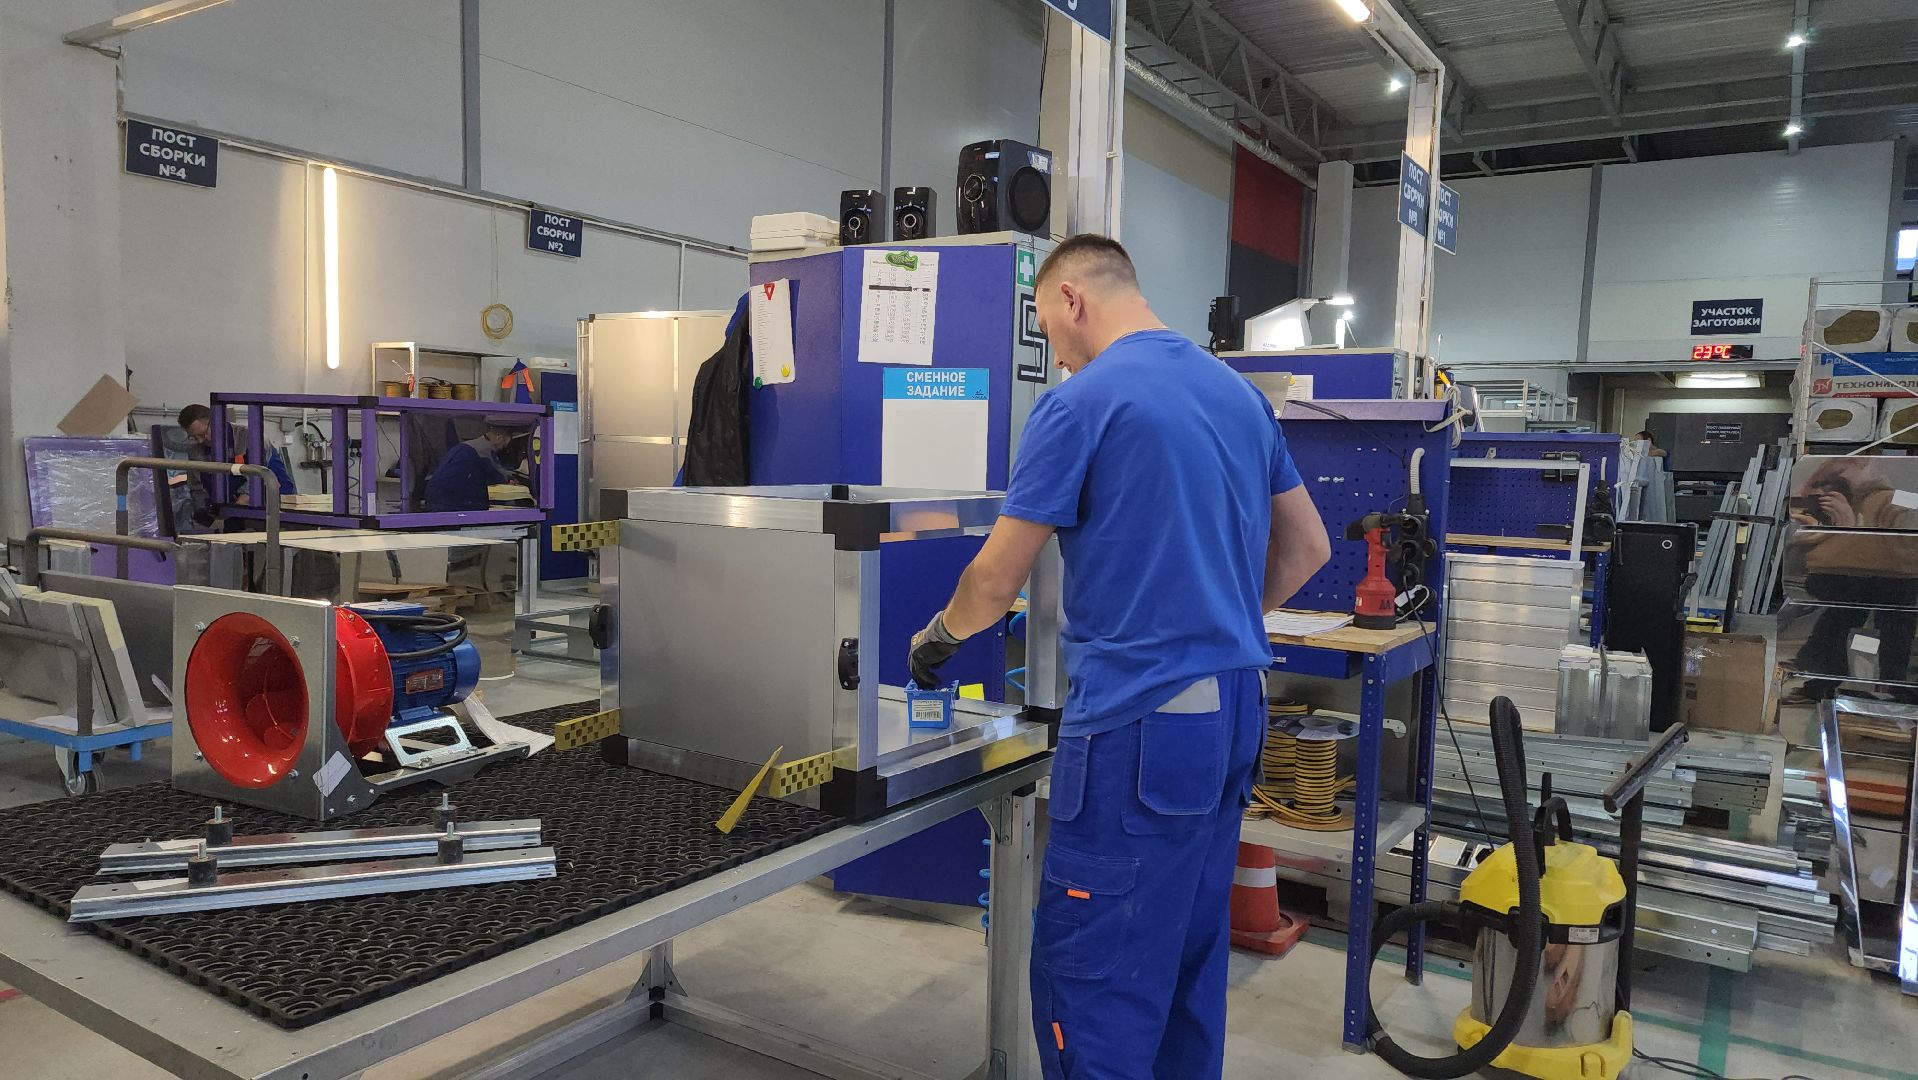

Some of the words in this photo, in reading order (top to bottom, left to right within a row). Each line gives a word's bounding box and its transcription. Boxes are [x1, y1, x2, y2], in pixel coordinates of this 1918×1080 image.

[152, 128, 196, 147] ПОСТ
[140, 143, 205, 167] СБОРКИ
[159, 164, 186, 179] №4
[1408, 162, 1423, 186] ПОСТ
[1404, 182, 1425, 211] СБОРКИ
[1440, 187, 1452, 207] ОСТ
[544, 214, 571, 228] ПОСТ
[1438, 208, 1454, 229] ОРКИ
[536, 225, 576, 242] СБОРКИ
[548, 241, 564, 252] №2
[1701, 307, 1754, 316] УЧАСТОК
[1692, 317, 1761, 328] ЗАГОТОВКИ
[906, 371, 966, 383] СМЕННОЕ
[906, 385, 965, 398] ЗАДАНИЕ
